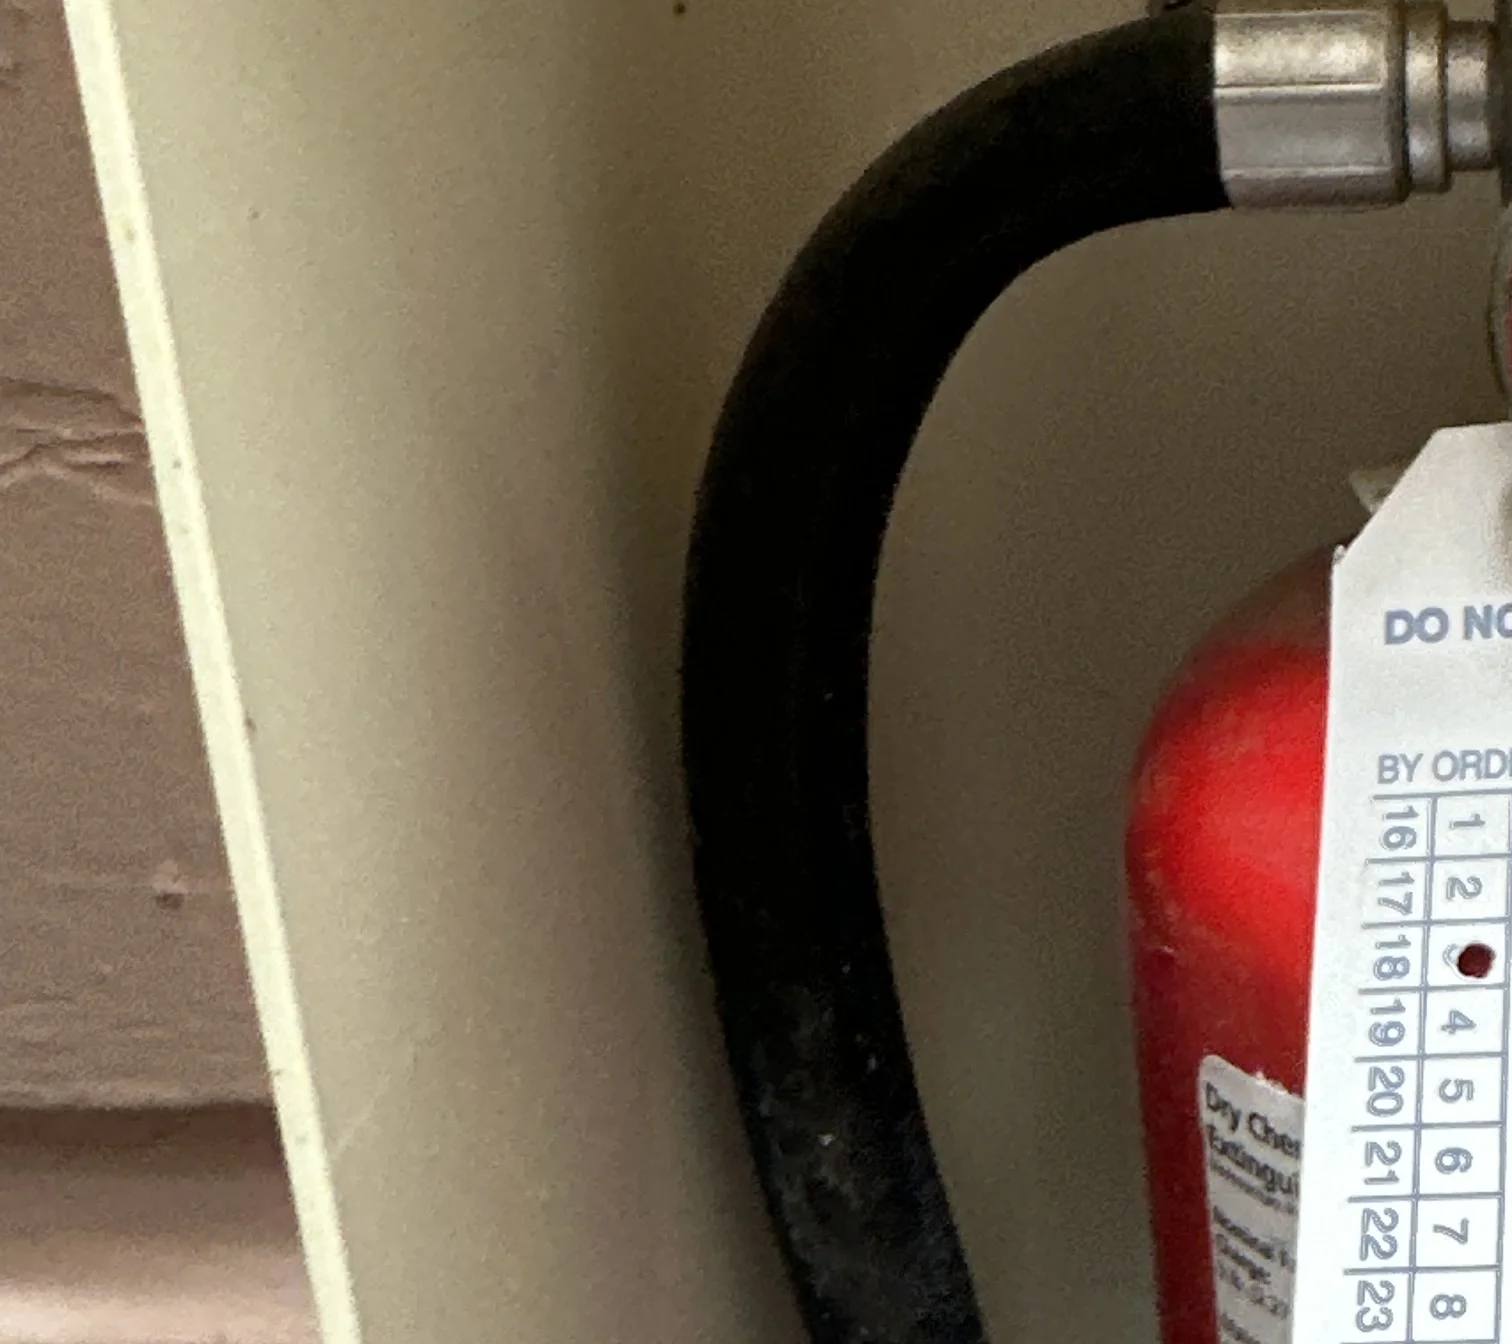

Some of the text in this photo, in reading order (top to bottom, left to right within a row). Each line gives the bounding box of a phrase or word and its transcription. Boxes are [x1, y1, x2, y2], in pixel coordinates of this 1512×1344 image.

[1384, 609, 1450, 645] DO
[1377, 752, 1425, 785] BY
[1380, 804, 1420, 850] 16
[1449, 812, 1486, 830] 1
[1377, 871, 1415, 916] 17
[1445, 875, 1483, 901] 2
[1373, 934, 1412, 981] 18
[1369, 998, 1407, 1046] 19
[1440, 1010, 1477, 1035] 4
[1366, 1065, 1405, 1118] 20
[1438, 1078, 1475, 1104] 5
[1364, 1140, 1402, 1186] 21
[1434, 1147, 1474, 1174] 6
[1359, 1207, 1400, 1261] 22
[1432, 1217, 1470, 1245] 7
[1355, 1279, 1395, 1333] 23
[1429, 1293, 1467, 1320] 8
